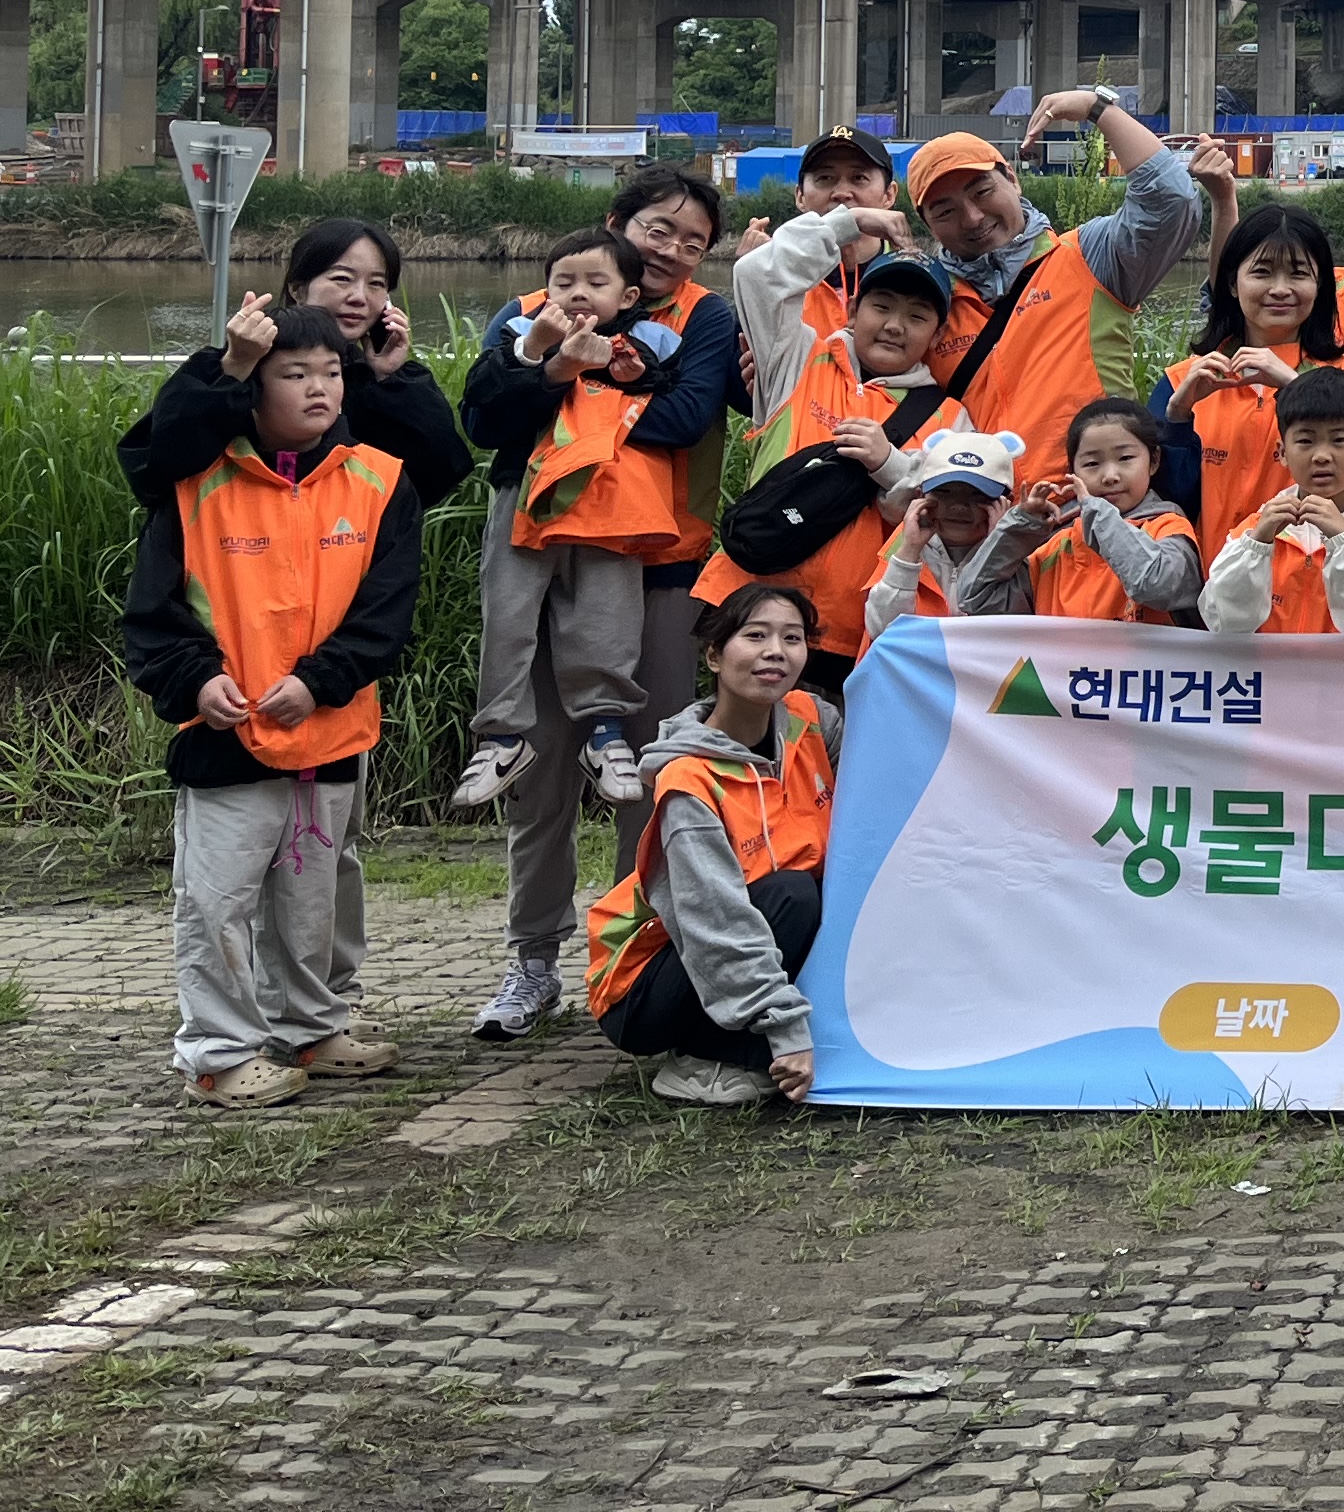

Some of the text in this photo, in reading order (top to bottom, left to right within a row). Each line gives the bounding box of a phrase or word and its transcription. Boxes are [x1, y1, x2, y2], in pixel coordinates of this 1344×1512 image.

[319, 530, 367, 550] 현대건설
[1068, 666, 1262, 725] 현대건설
[1214, 998, 1289, 1038] 날짜
